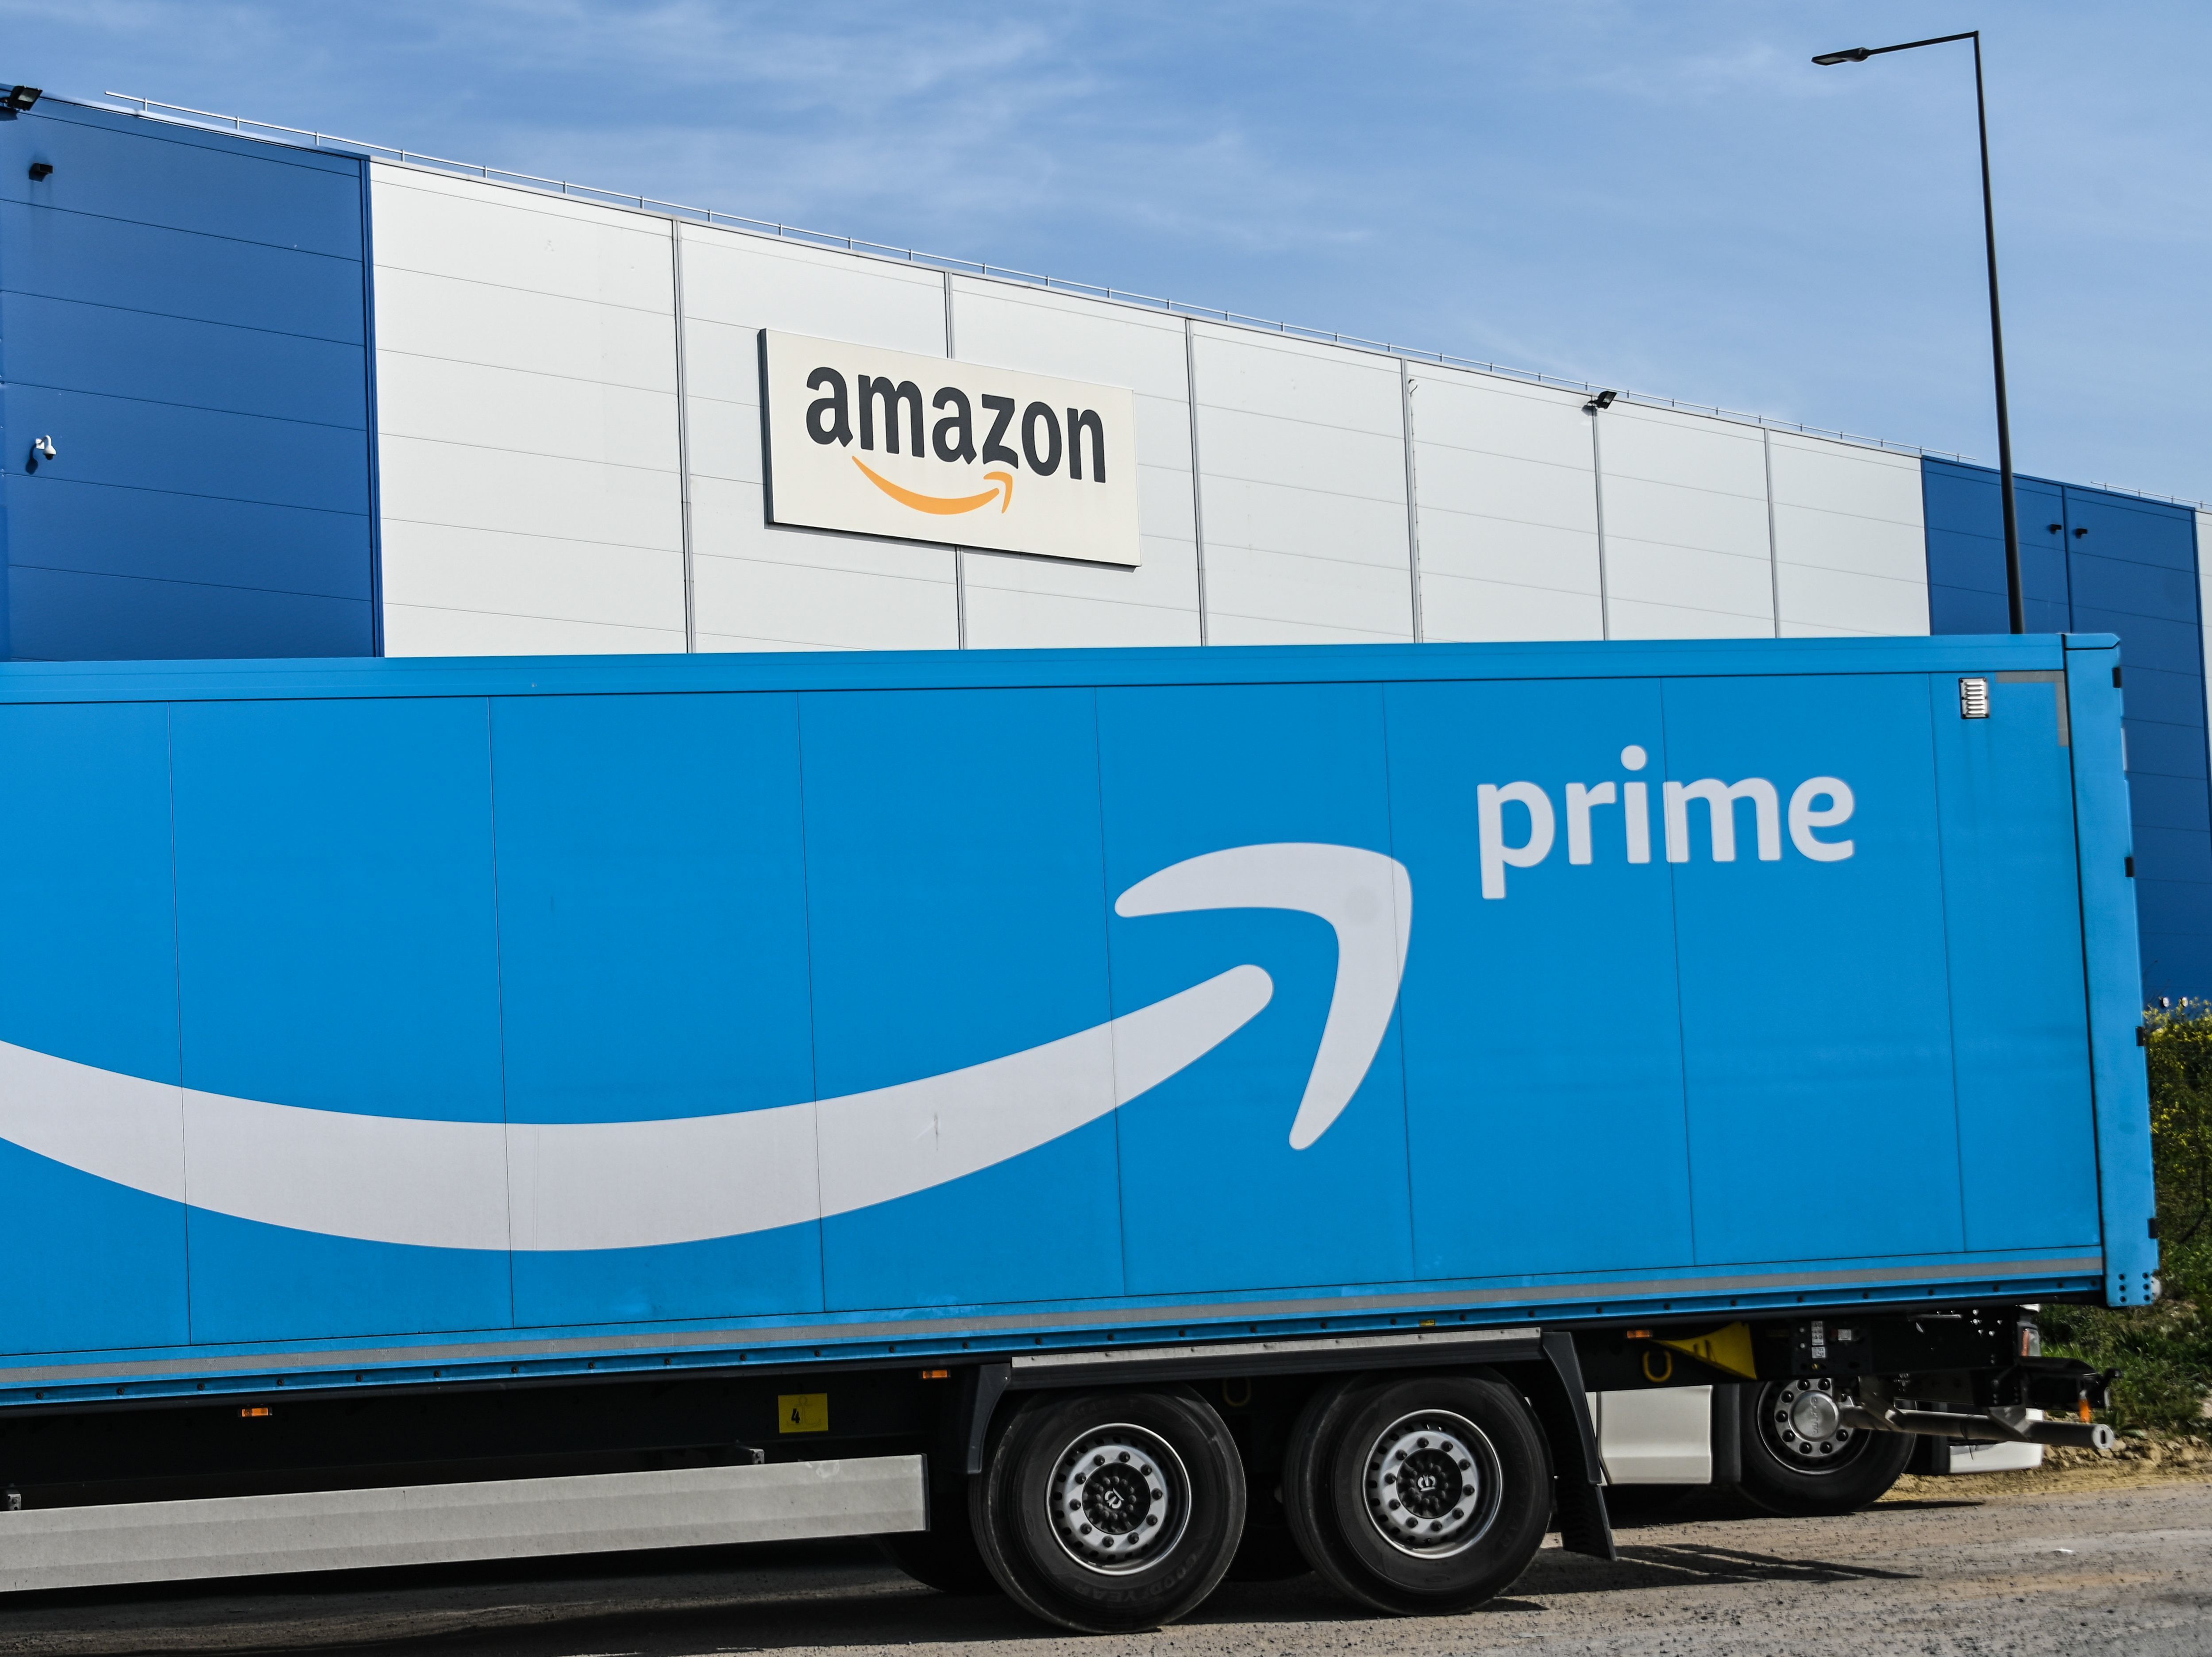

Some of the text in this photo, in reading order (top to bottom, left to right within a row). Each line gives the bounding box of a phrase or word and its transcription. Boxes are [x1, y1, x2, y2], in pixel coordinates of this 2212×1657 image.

[806, 367, 1106, 483] amazon
[1476, 744, 1854, 899] prime
[791, 1408, 800, 1424] 4
